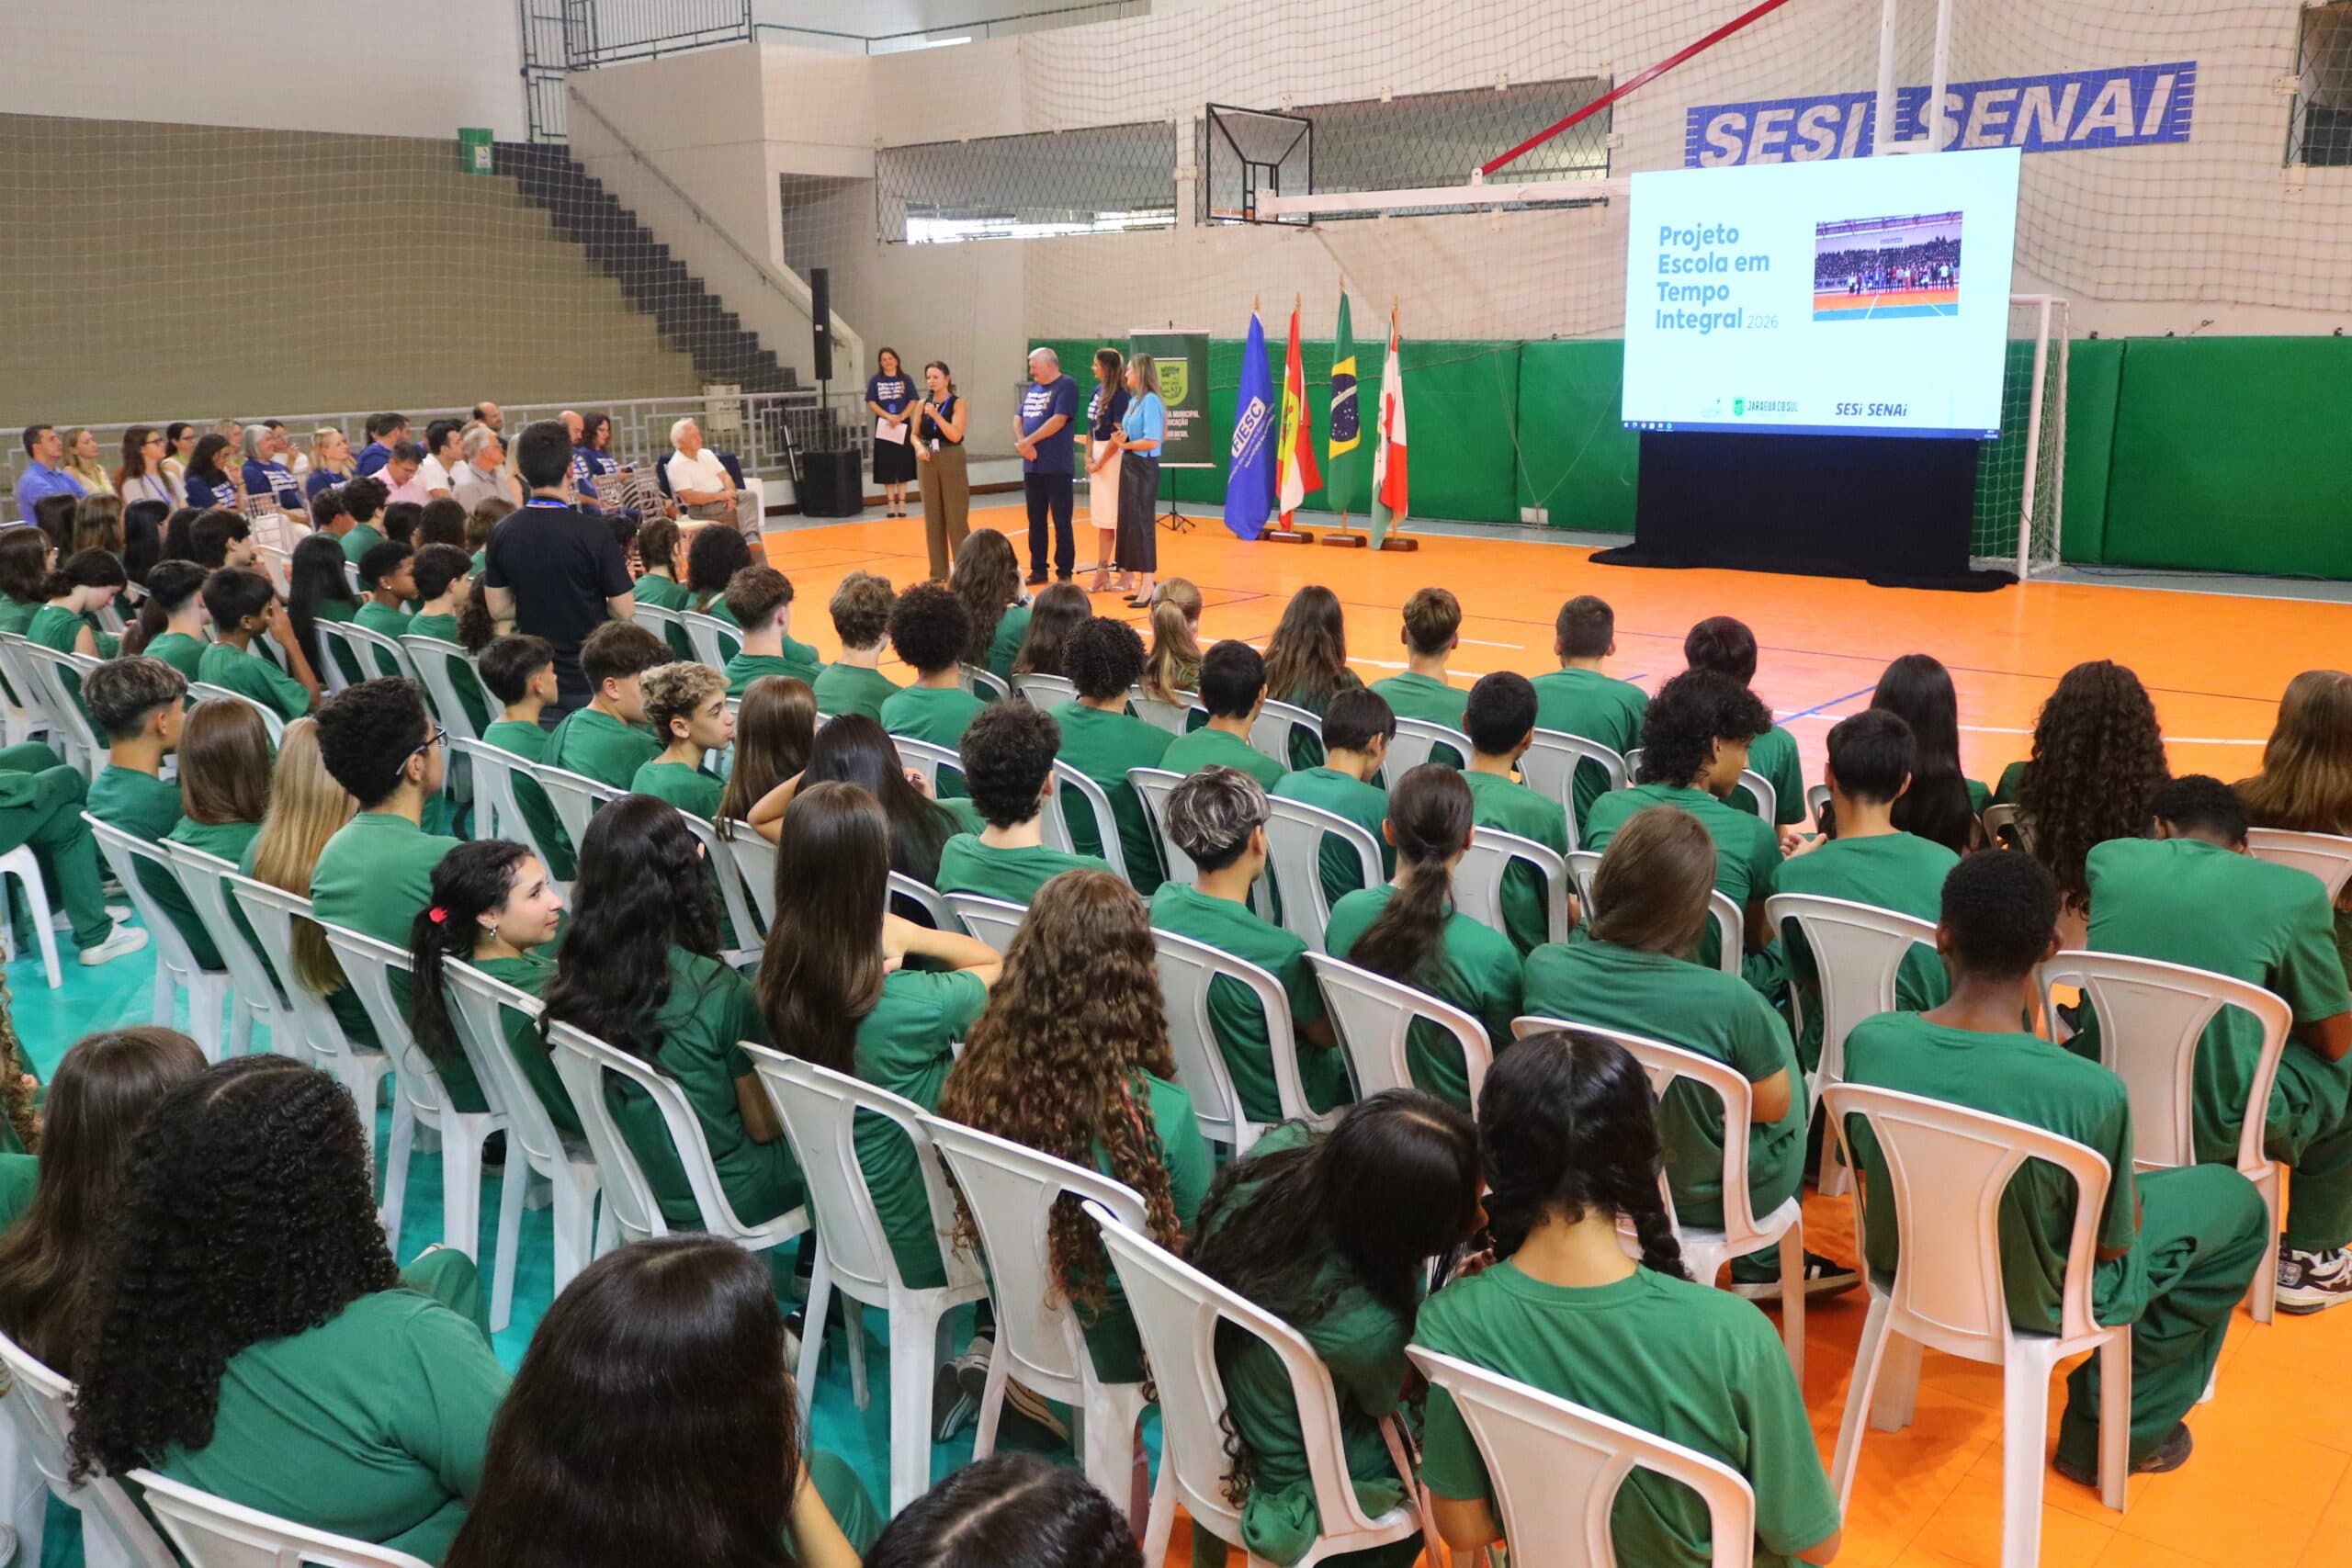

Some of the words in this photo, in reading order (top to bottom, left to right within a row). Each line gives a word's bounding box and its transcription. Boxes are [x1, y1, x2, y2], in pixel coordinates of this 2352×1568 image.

[1700, 102, 1867, 168] SESI
[1917, 73, 2176, 151] SENAI
[1659, 222, 1739, 252] Projeto
[1658, 251, 1728, 275] Escola
[1735, 254, 1770, 272] em
[1657, 281, 1730, 307] Tempo
[1656, 307, 1743, 335] Integral
[1747, 314, 1780, 329] 2026
[1232, 402, 1262, 453] FIESC
